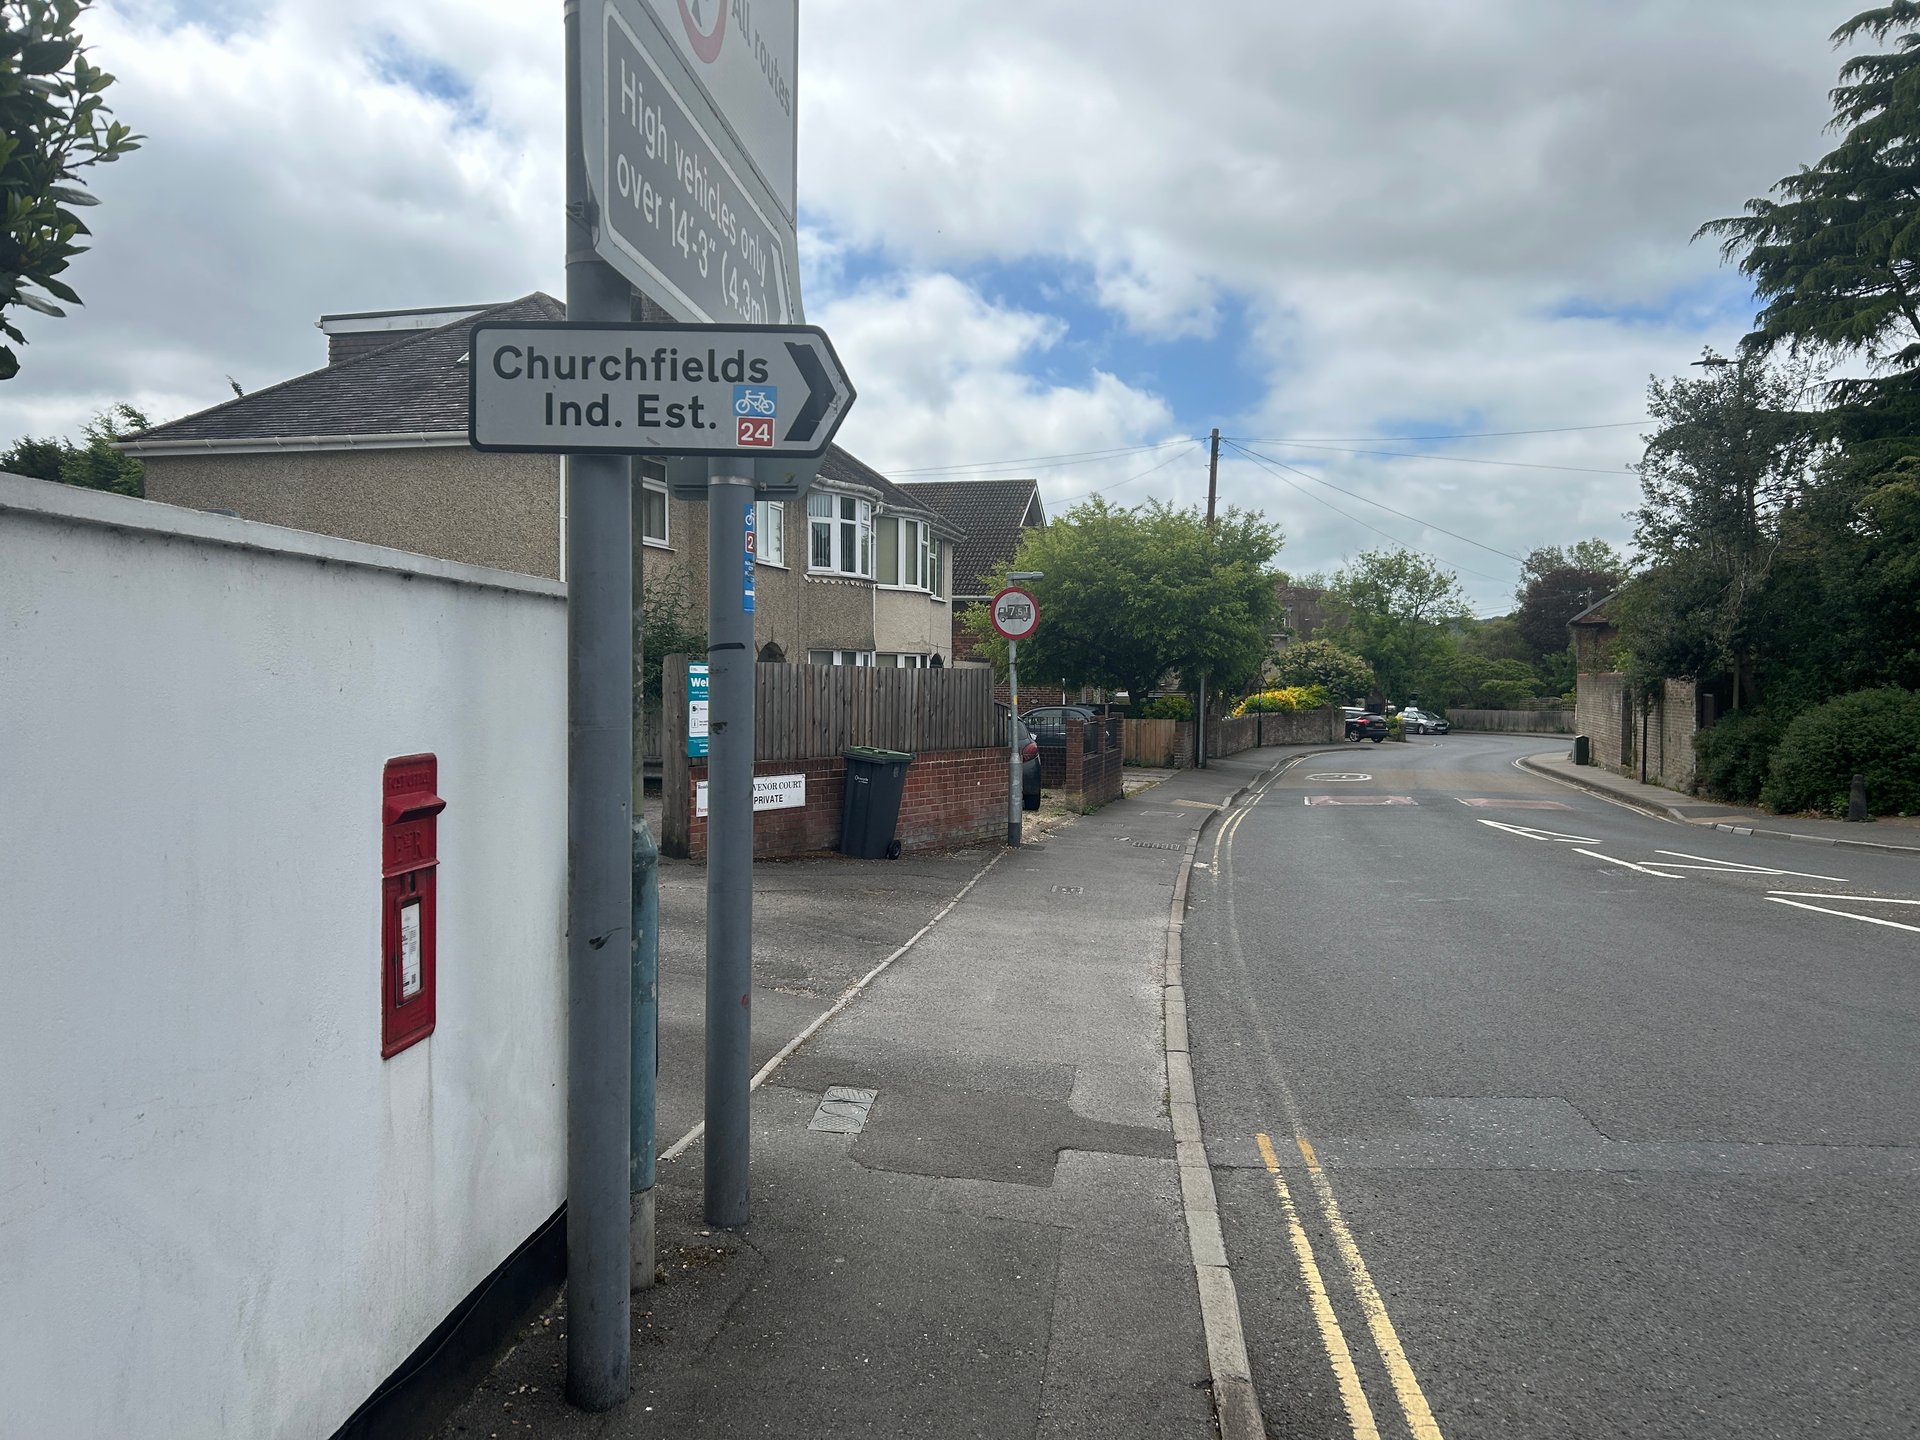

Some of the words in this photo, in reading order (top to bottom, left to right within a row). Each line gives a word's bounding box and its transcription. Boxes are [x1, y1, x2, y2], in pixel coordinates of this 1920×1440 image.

[731, 0, 751, 48] All
[754, 28, 790, 117] routes
[616, 153, 662, 230] over
[620, 57, 668, 165] High
[674, 139, 737, 246] vehicles
[741, 227, 766, 288] only
[492, 344, 769, 384] Churchfields
[544, 392, 622, 428] Ind.
[637, 394, 717, 430] Est.
[740, 422, 770, 443] 24
[753, 782, 778, 792] VENOR
[779, 780, 802, 790] COURT
[754, 794, 783, 804] PRIVATE
